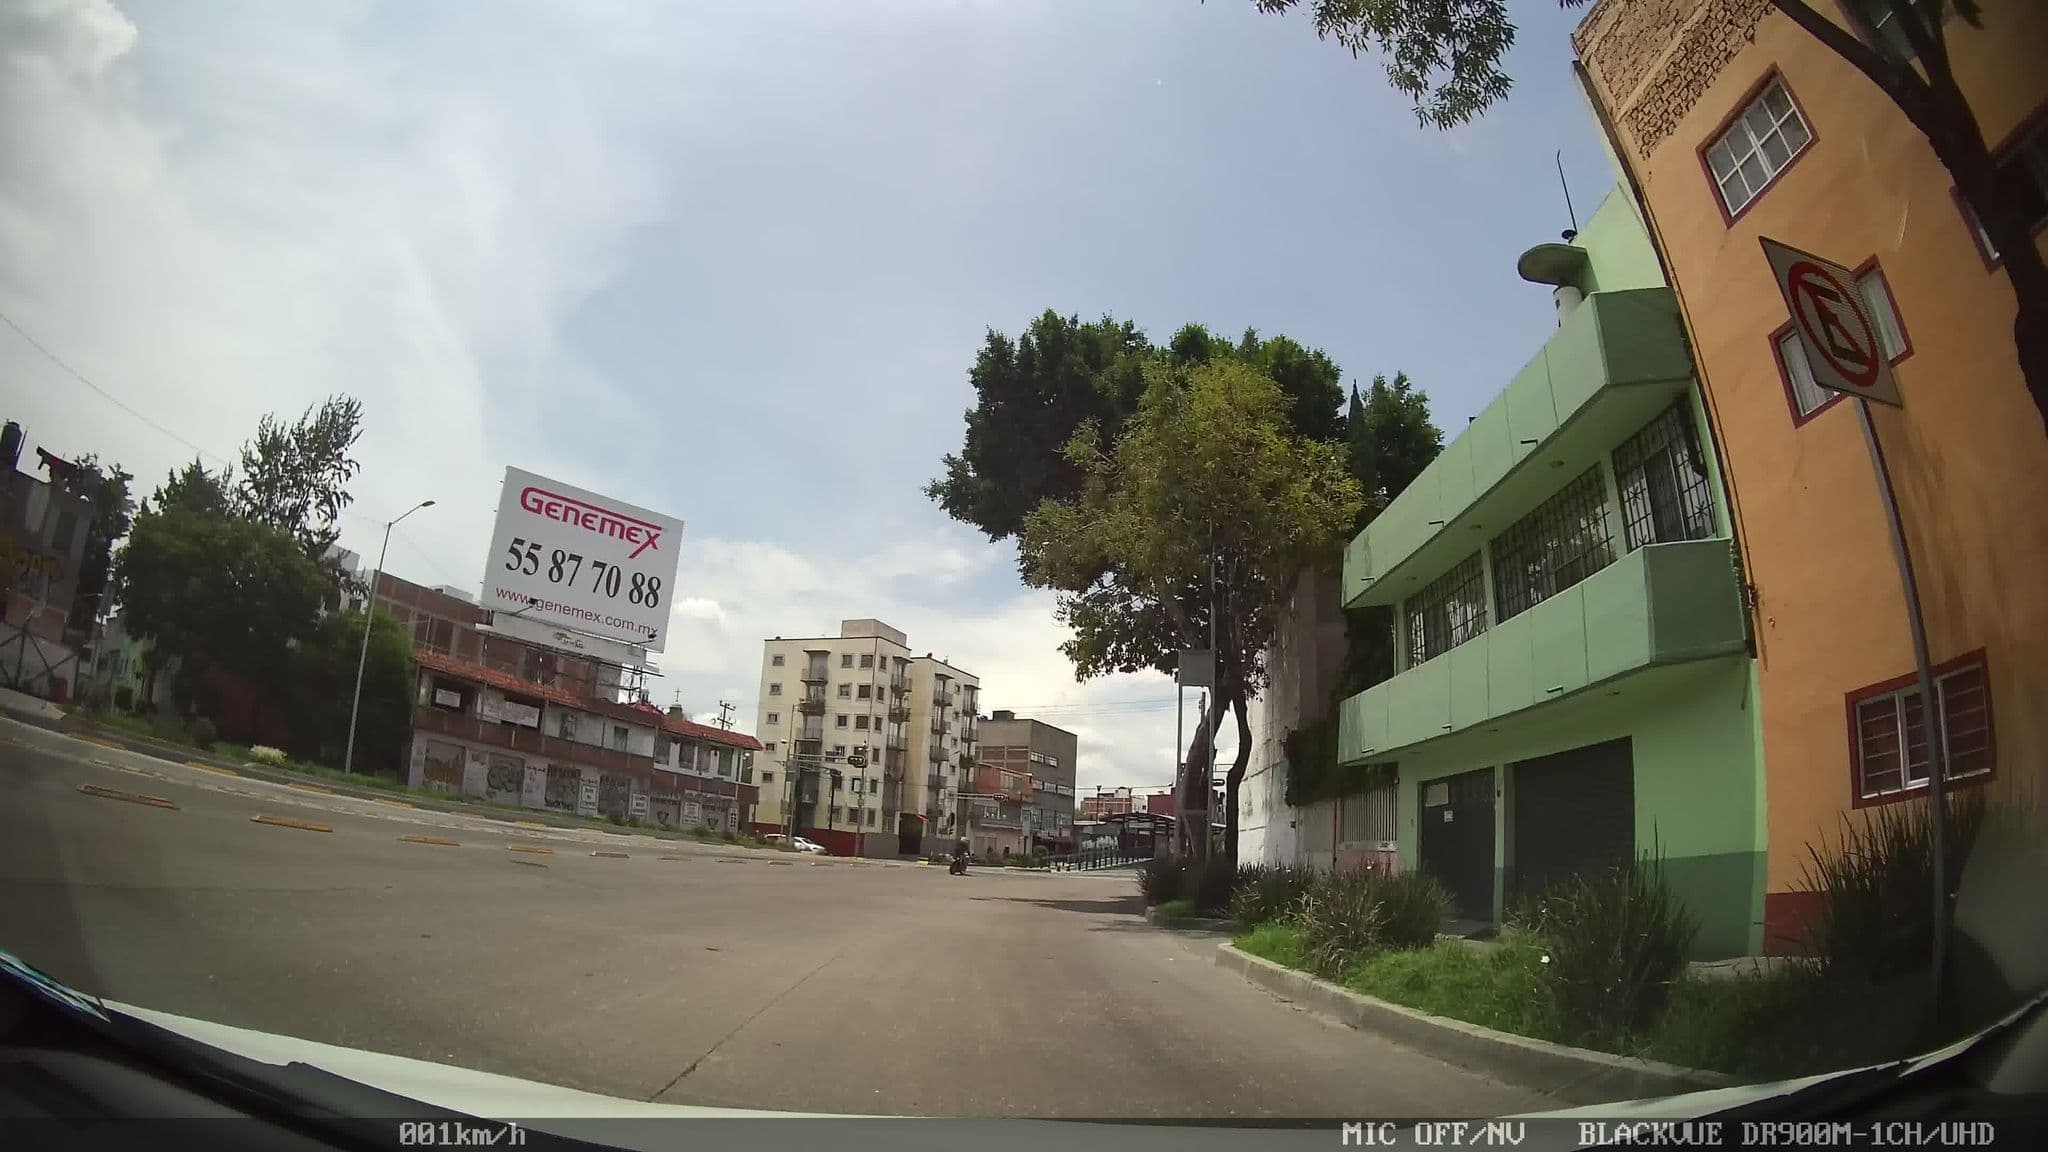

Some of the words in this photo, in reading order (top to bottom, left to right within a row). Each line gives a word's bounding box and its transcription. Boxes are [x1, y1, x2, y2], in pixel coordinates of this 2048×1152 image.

[505, 537, 542, 576] 55
[548, 549, 583, 587] 87
[592, 560, 621, 598] 70
[629, 572, 661, 609] 88
[496, 586, 658, 635] wwwgenemex.com.mx
